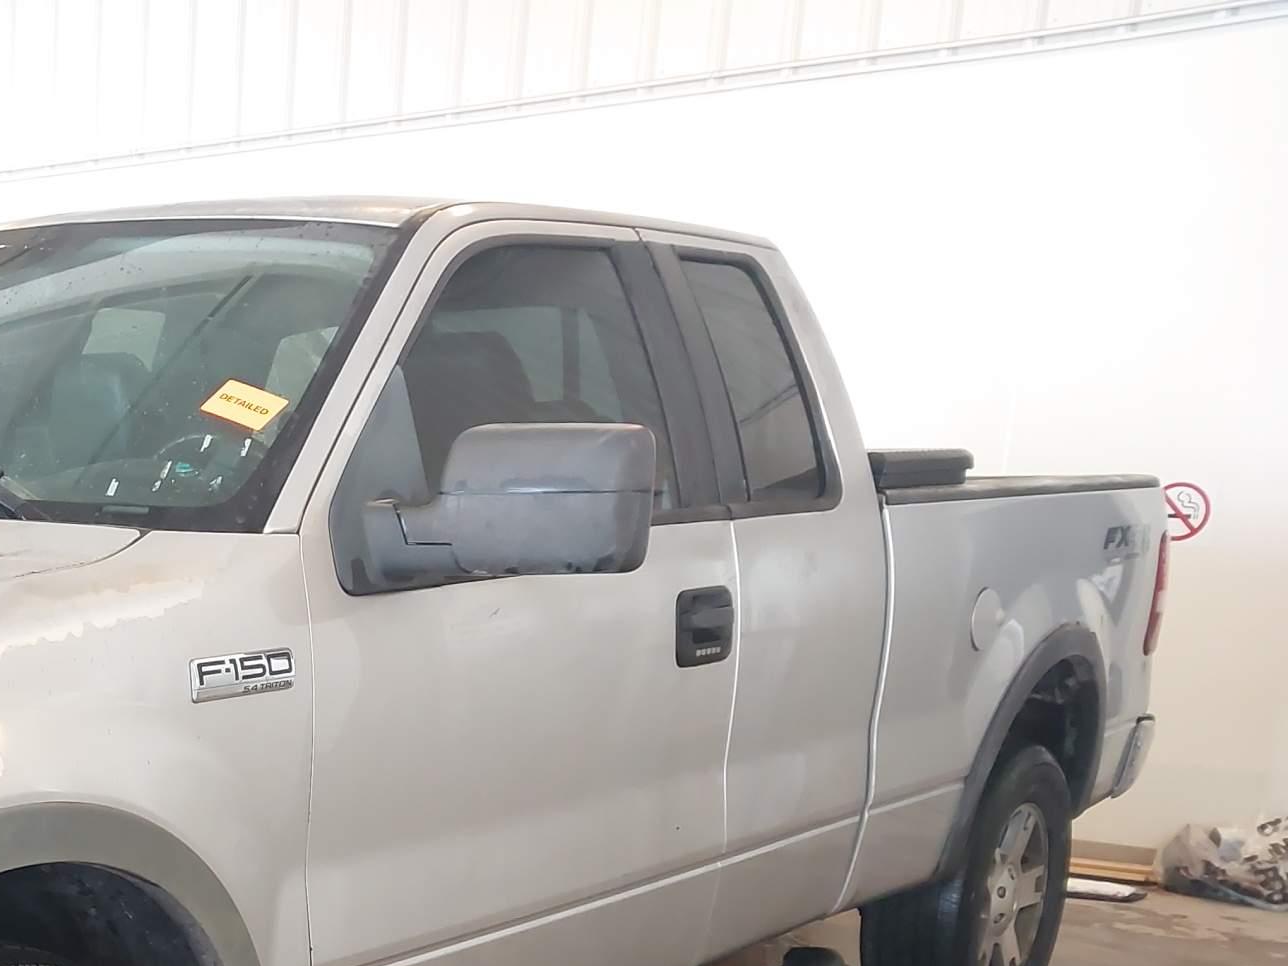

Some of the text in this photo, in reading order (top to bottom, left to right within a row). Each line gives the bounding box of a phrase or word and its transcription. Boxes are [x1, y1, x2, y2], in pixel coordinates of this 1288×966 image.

[219, 393, 269, 415] DETAILED
[196, 652, 293, 686] F-150
[260, 679, 292, 691] TRITON
